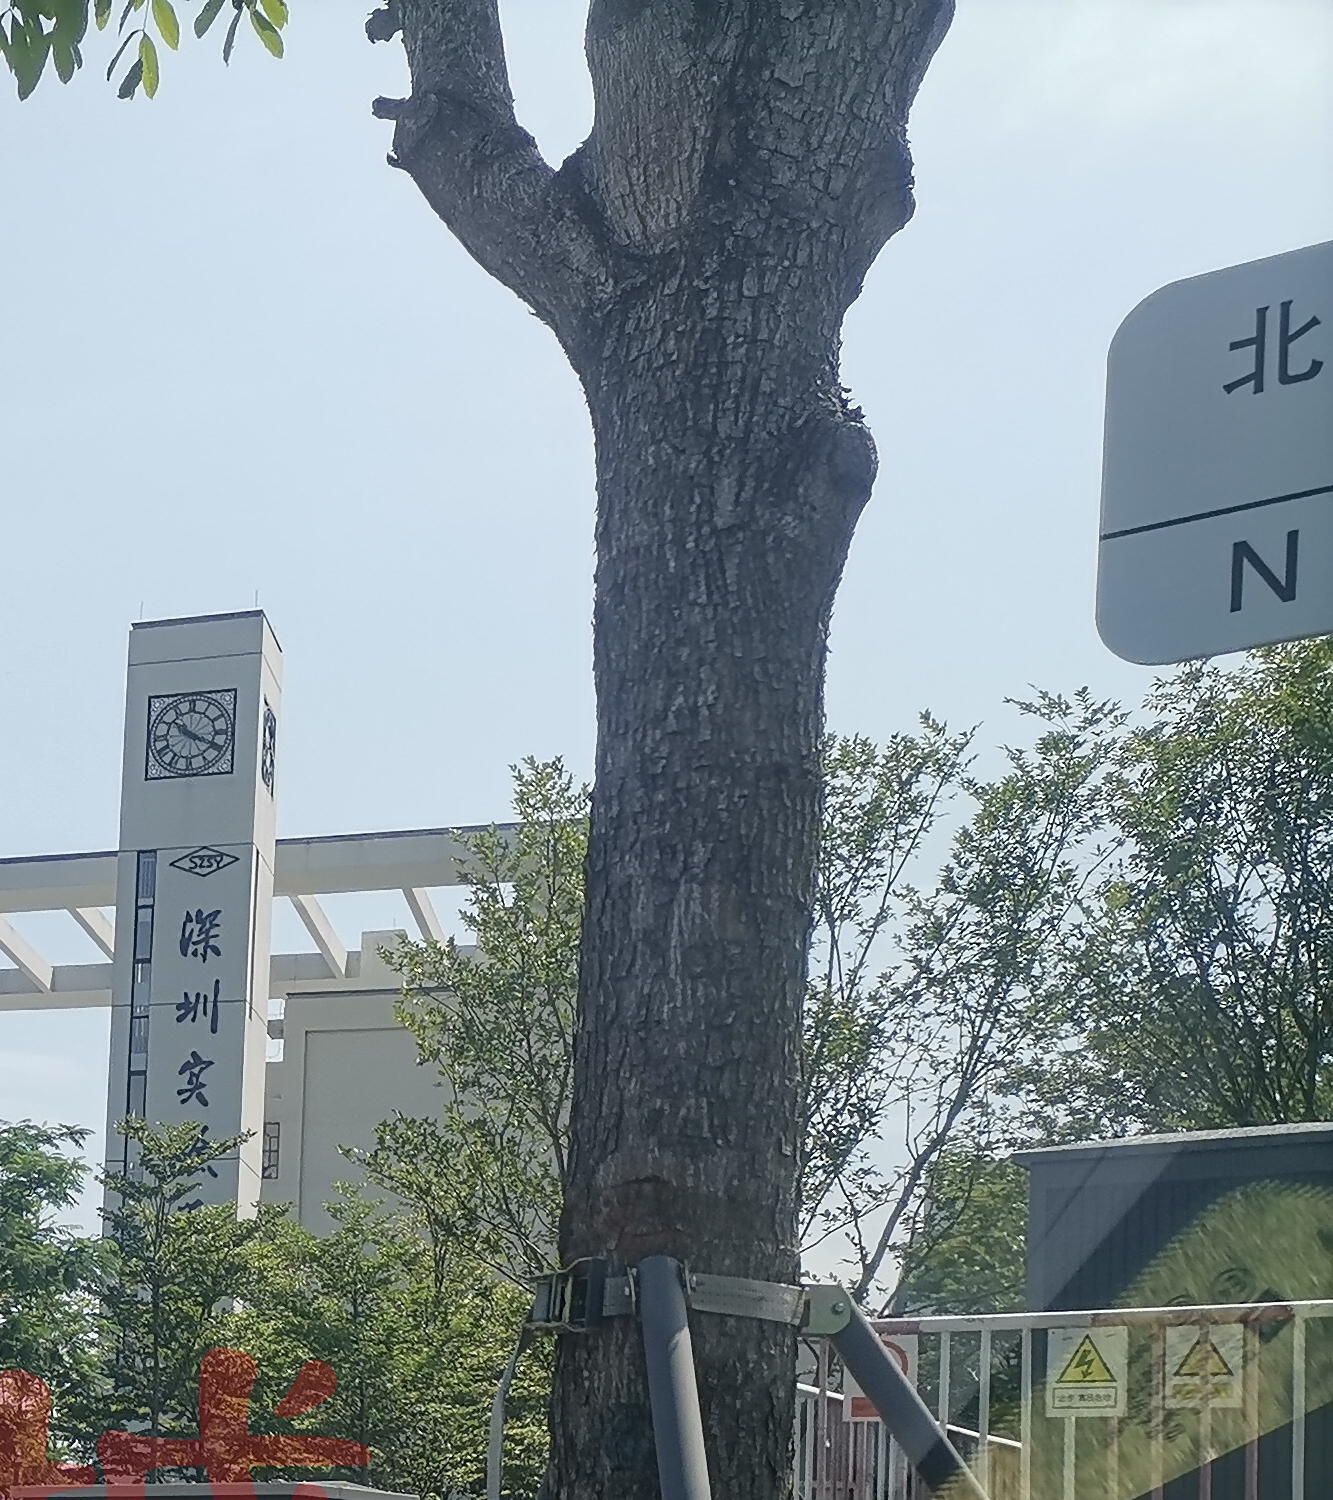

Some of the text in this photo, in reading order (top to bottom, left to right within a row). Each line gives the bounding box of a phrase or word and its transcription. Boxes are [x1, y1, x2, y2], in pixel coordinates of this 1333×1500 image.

[1222, 299, 1324, 395] 北
[1229, 529, 1300, 613] N
[175, 908, 223, 1211] 深圳实
